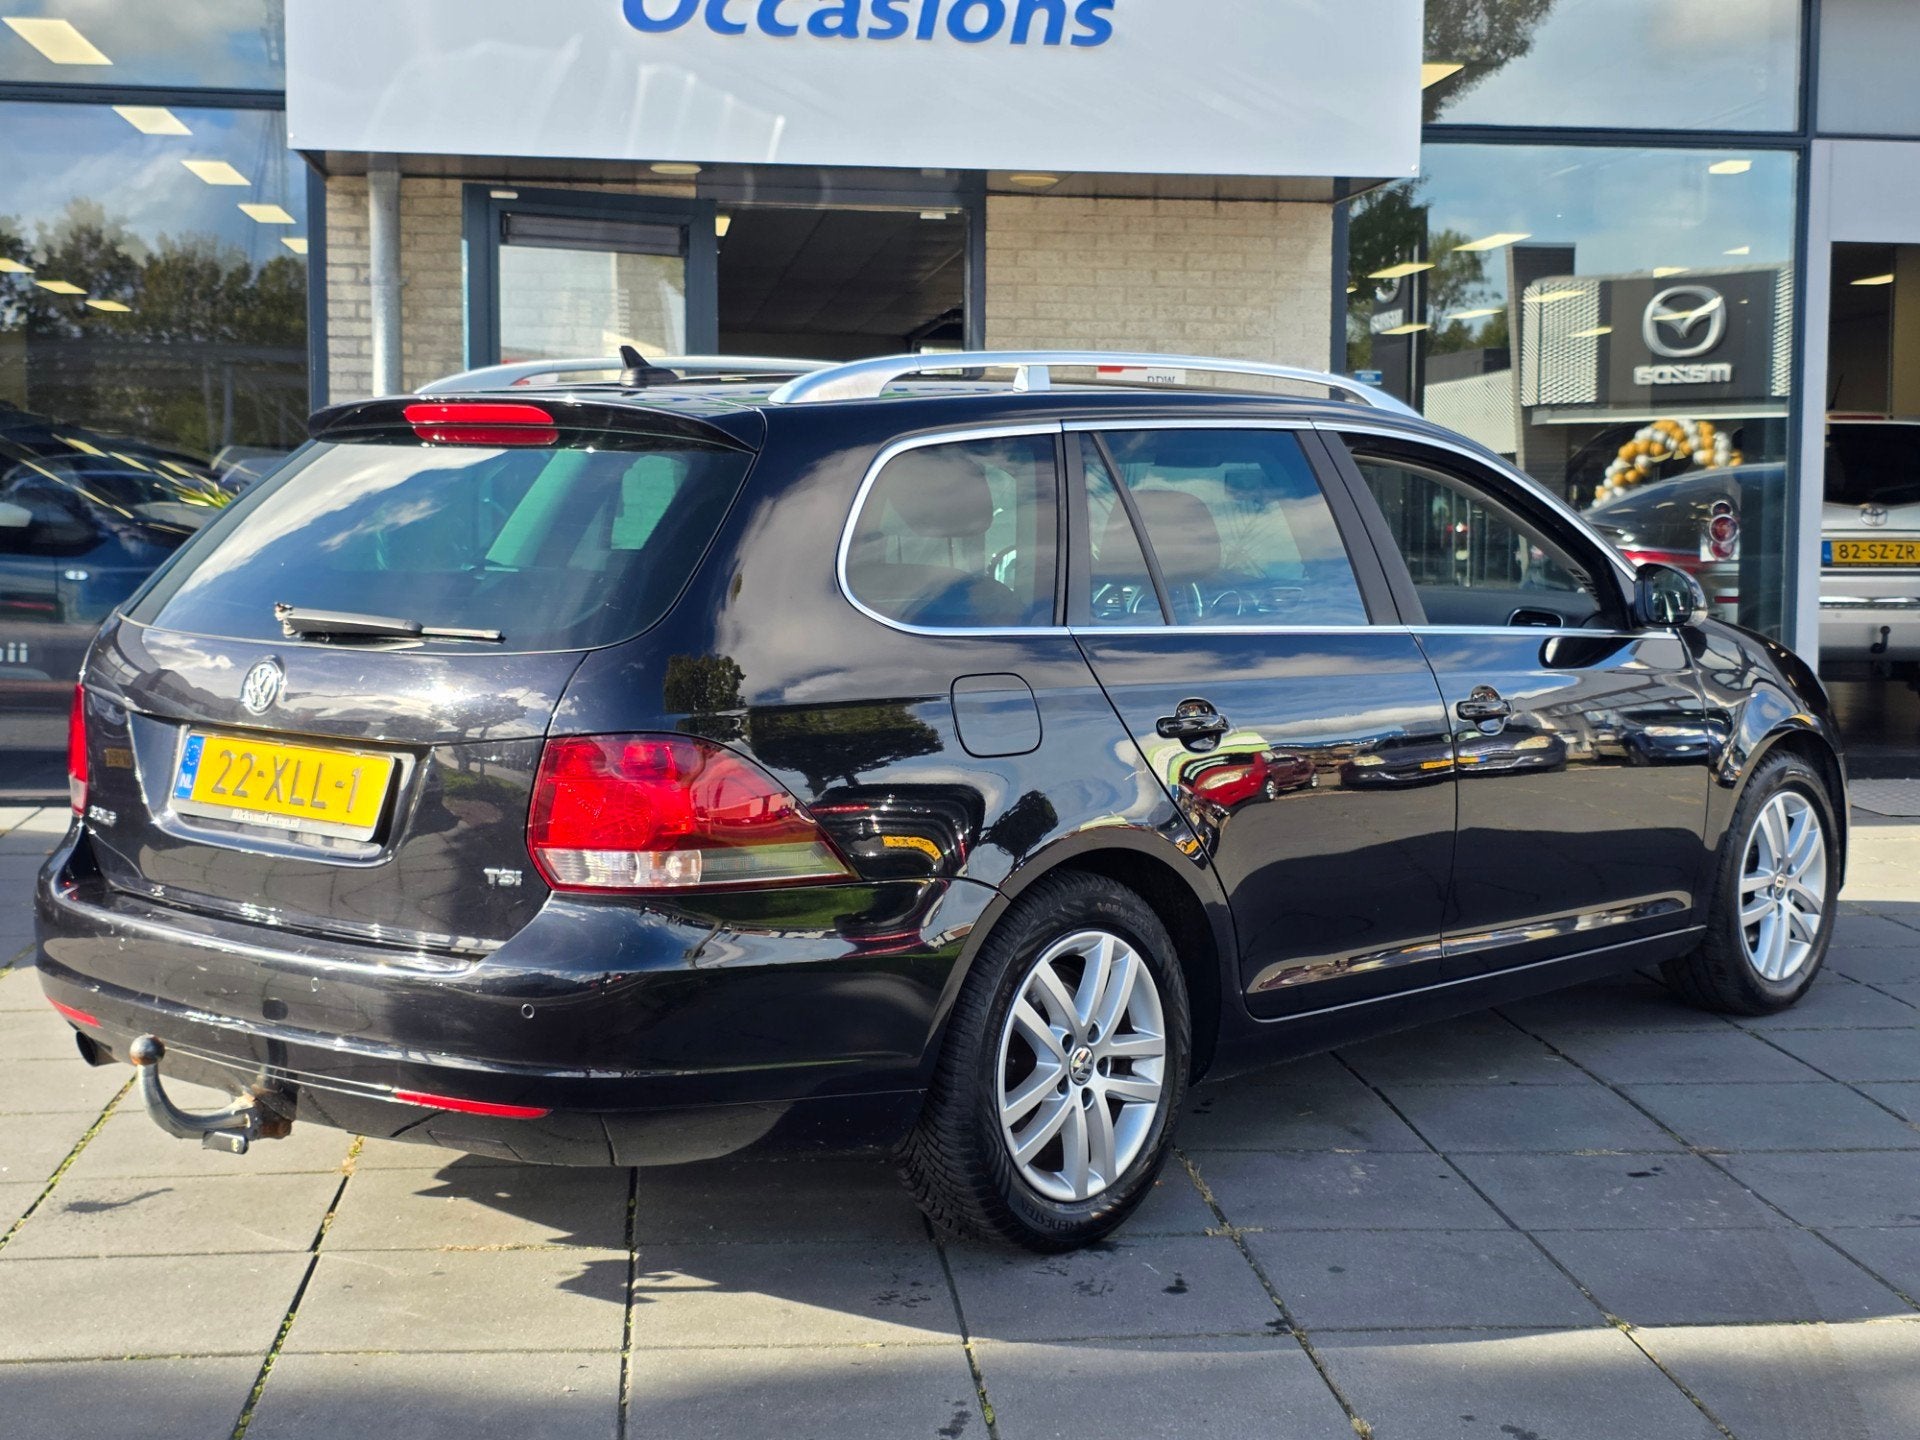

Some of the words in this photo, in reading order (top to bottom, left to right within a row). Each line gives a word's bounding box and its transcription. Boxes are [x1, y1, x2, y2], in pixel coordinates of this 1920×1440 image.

[622, 0, 1114, 47] Occasions
[1838, 544, 1916, 560] 82-SZ-ZR
[211, 749, 364, 814] 22-XLL-1
